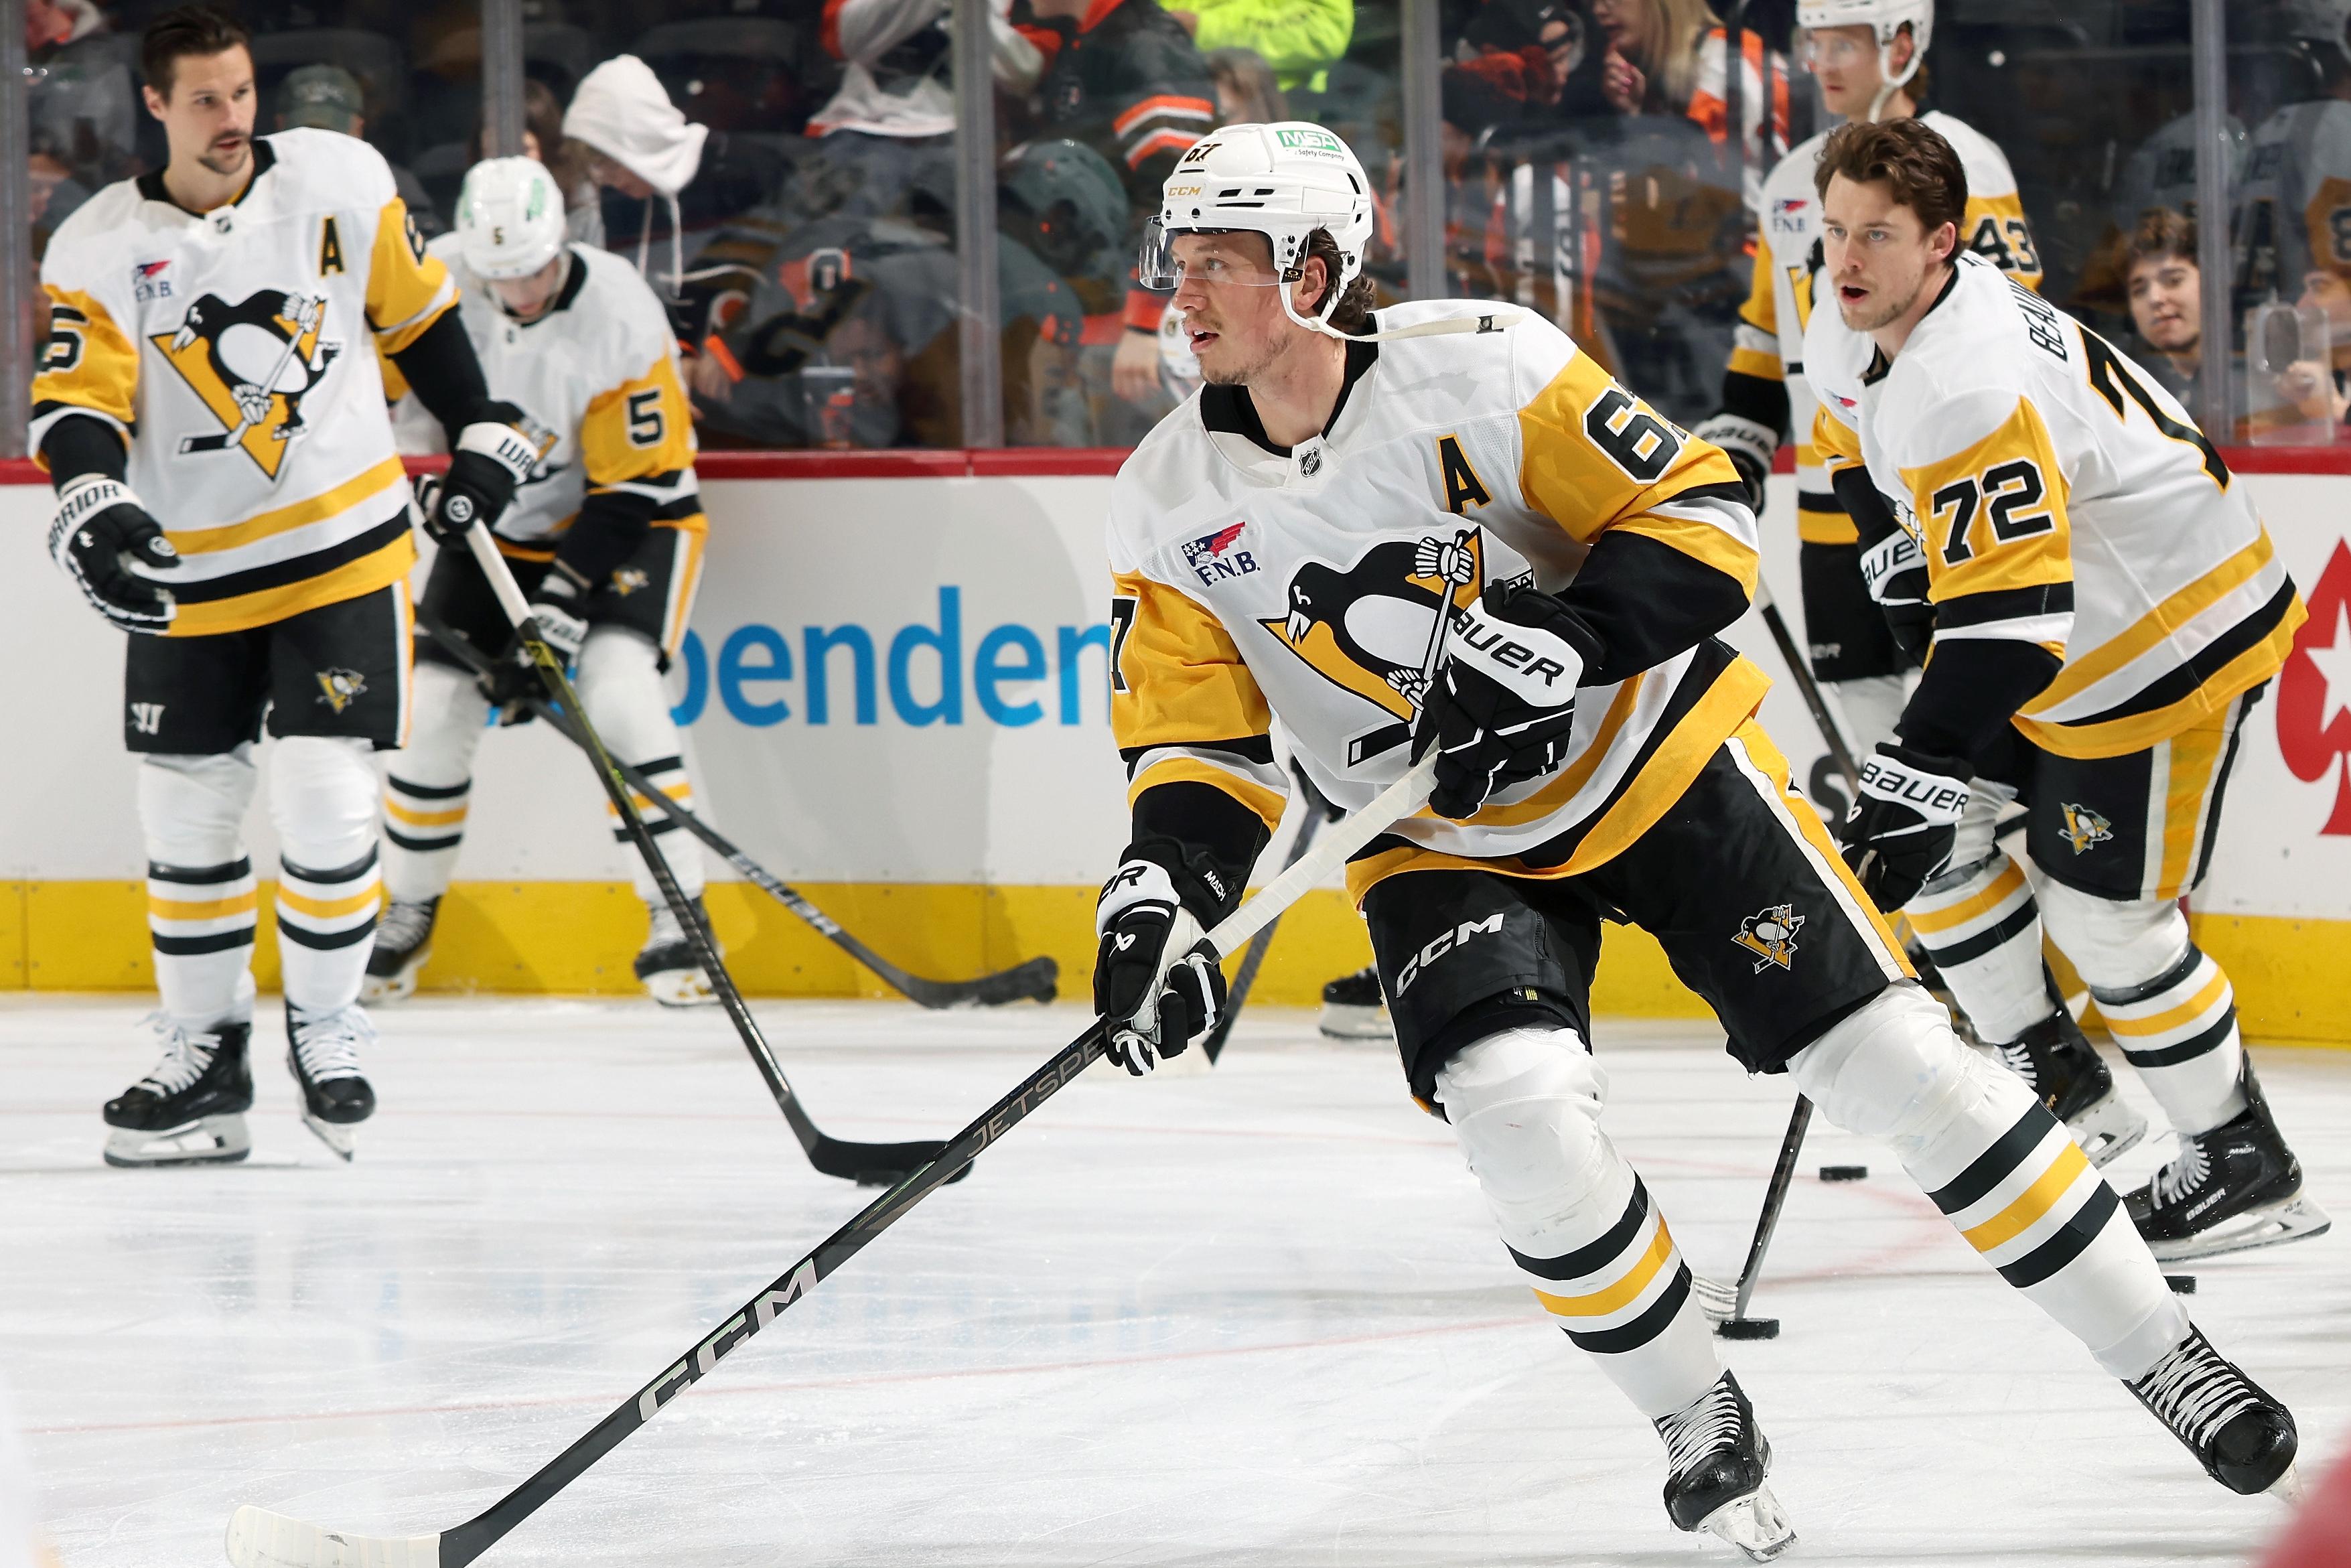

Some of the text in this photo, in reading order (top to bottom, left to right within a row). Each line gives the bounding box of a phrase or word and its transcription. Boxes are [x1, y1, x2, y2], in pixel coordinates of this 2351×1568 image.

[1280, 131, 1340, 150] MSA
[1167, 186, 1202, 197] CCM
[319, 215, 345, 277] A
[1971, 216, 2043, 273] 43
[626, 384, 667, 449] 5
[1582, 376, 1689, 485] 6
[1435, 432, 1494, 515] A
[1931, 455, 2059, 569] 72
[1194, 551, 1261, 587] F.N.B.
[1204, 870, 1227, 902] MACH
[1396, 912, 1504, 999] CCM
[638, 1257, 818, 1421] CCM
